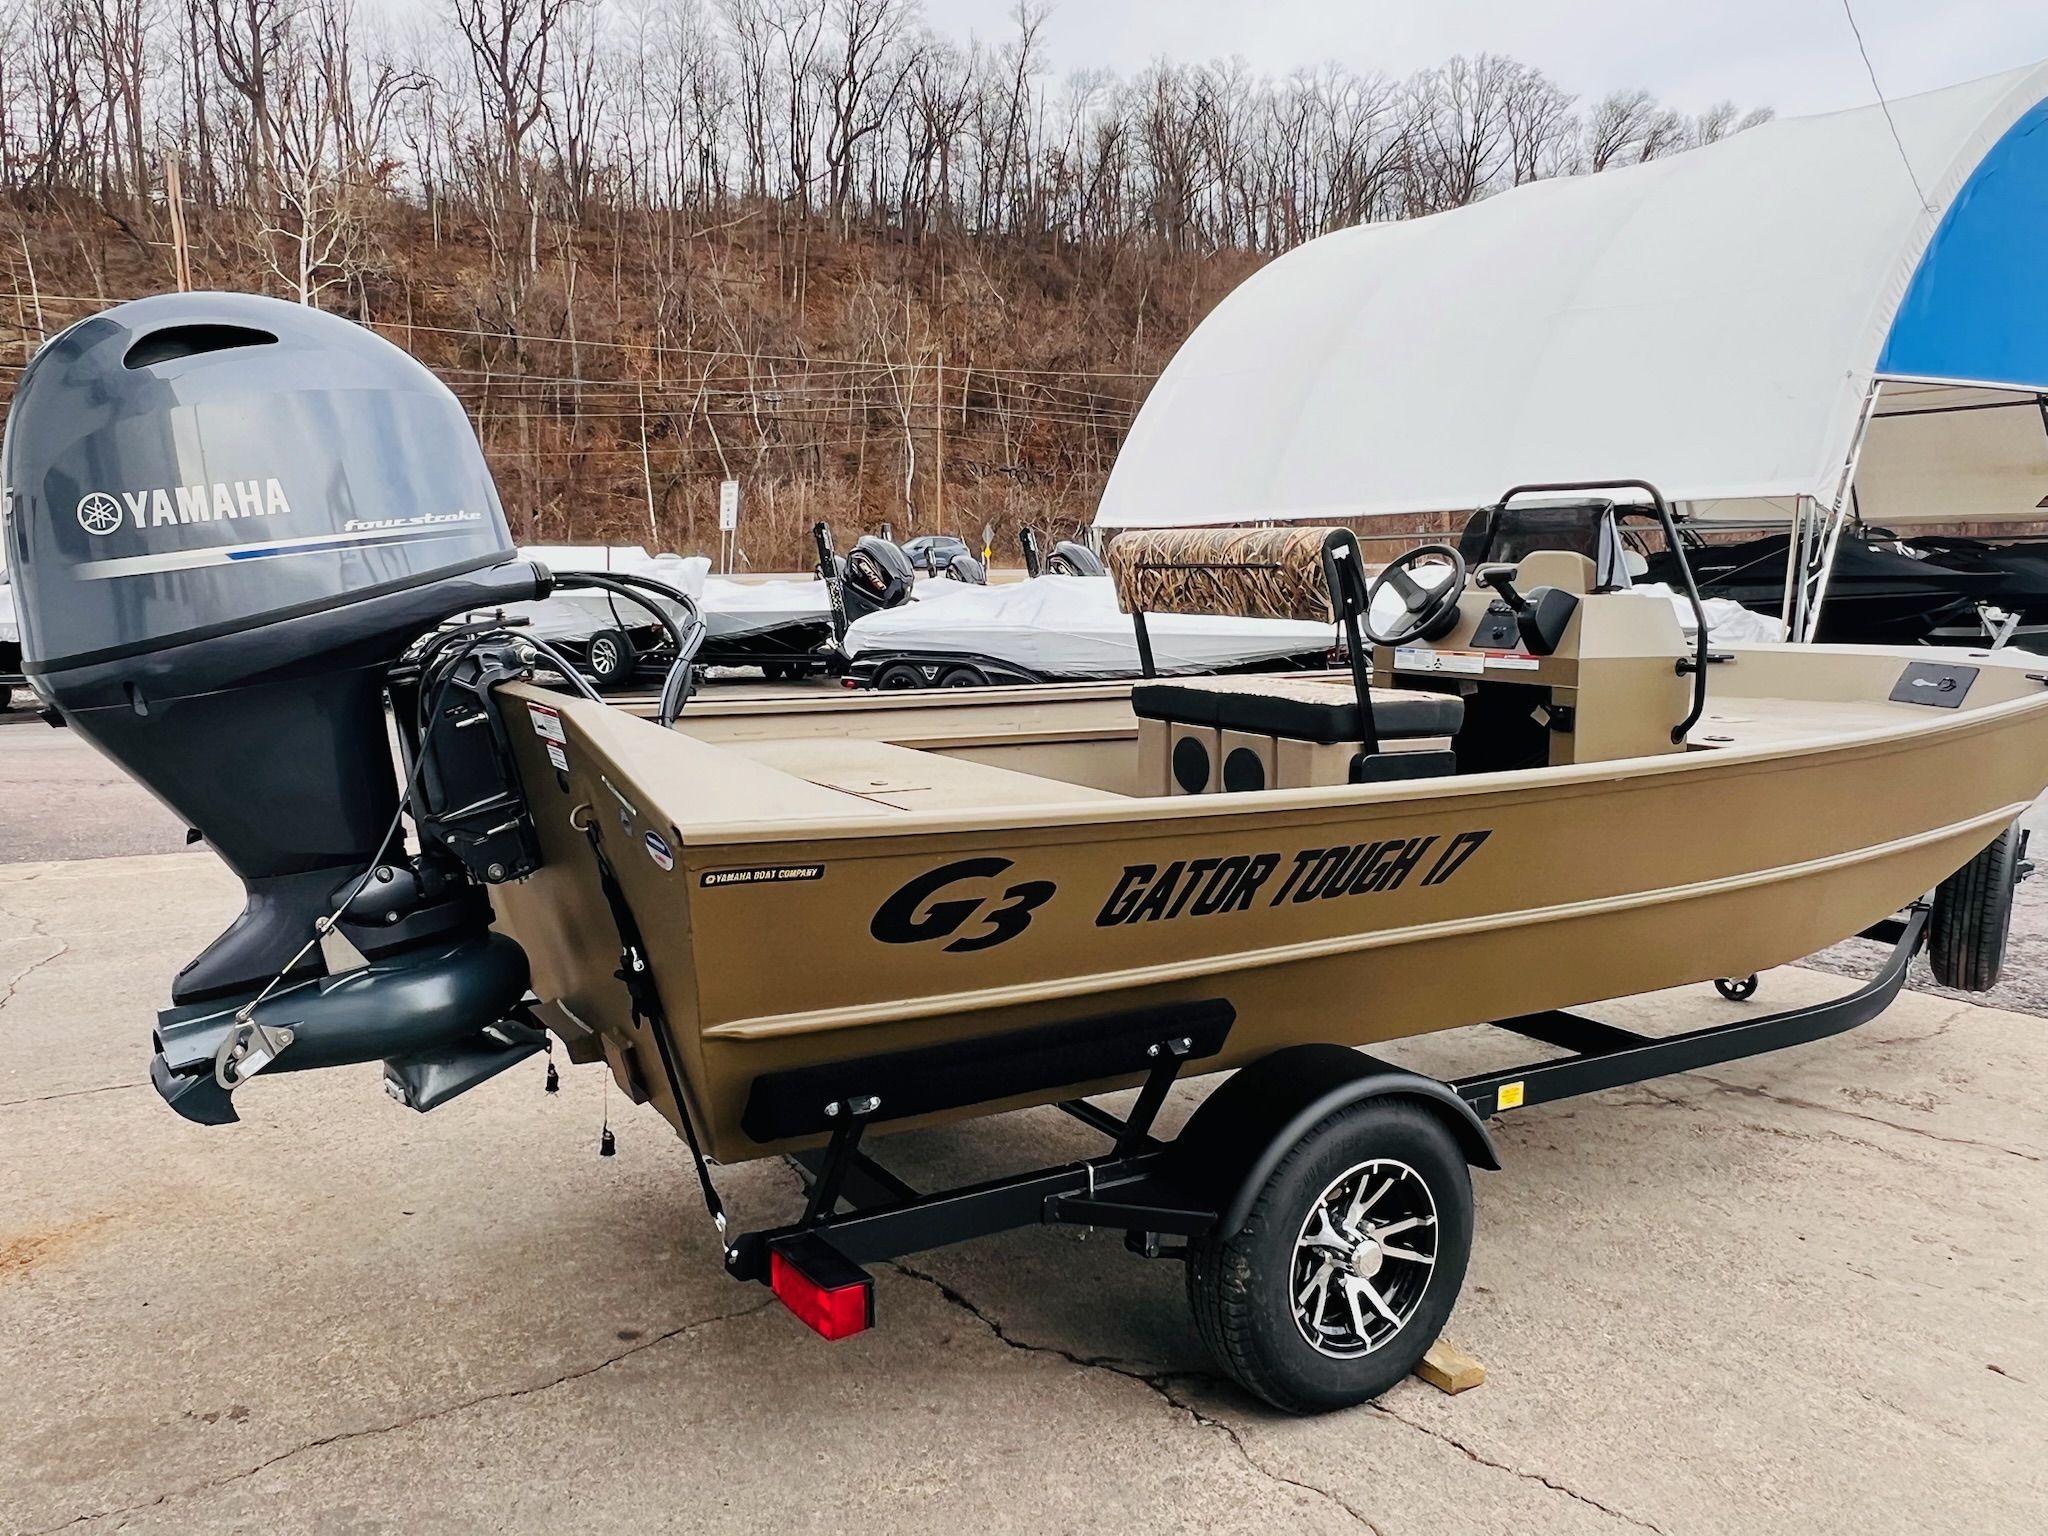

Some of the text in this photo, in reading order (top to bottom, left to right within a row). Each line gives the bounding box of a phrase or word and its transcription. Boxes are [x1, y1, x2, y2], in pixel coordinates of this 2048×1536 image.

[122, 478, 291, 529] YAMAHA
[715, 868, 818, 883] YAMAHA BOAT COMPANY
[870, 857, 1057, 952] G3
[1095, 830, 1493, 927] GATOR TOUGH 17
